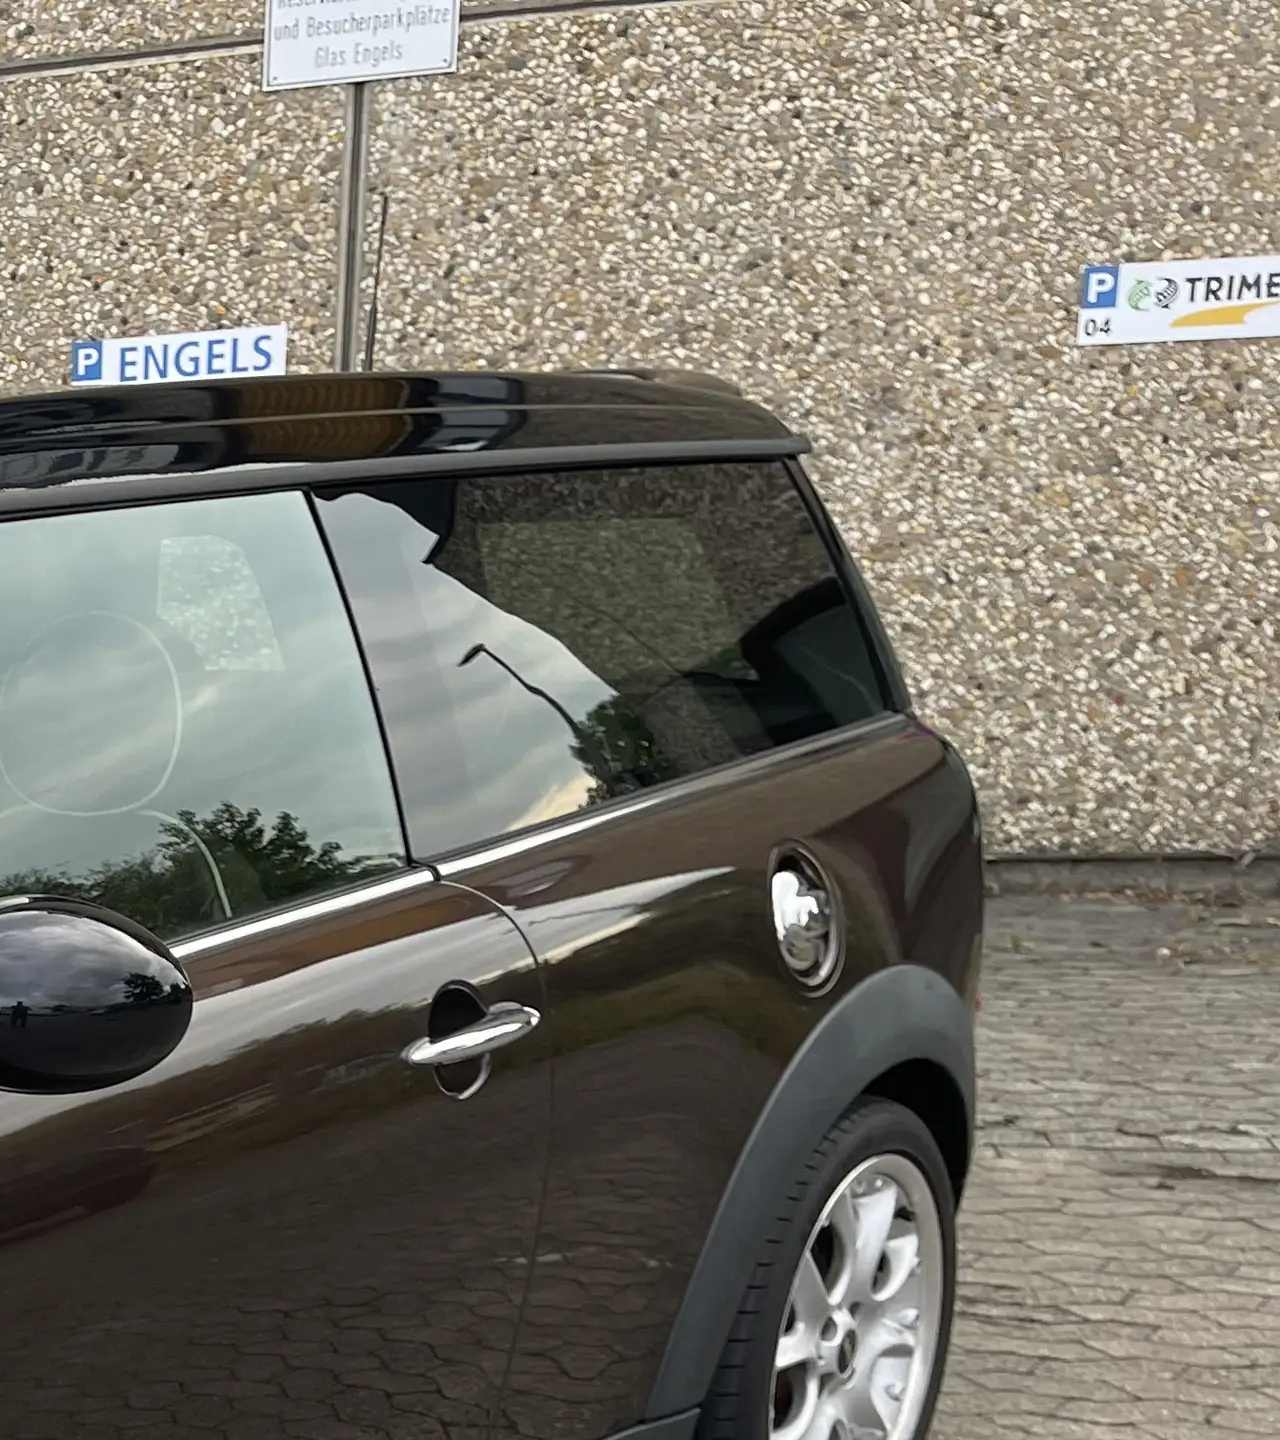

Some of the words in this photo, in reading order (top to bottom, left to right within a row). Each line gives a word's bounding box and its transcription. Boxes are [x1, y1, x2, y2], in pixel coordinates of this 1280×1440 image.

[274, 18, 299, 41] und
[306, 5, 451, 38] Besucherparkplätze
[315, 46, 347, 68] Glas
[353, 39, 403, 68] Engels
[1087, 272, 1115, 304] P
[1084, 317, 1112, 337] 04
[77, 347, 100, 377] P
[119, 335, 273, 383] ENGELS
